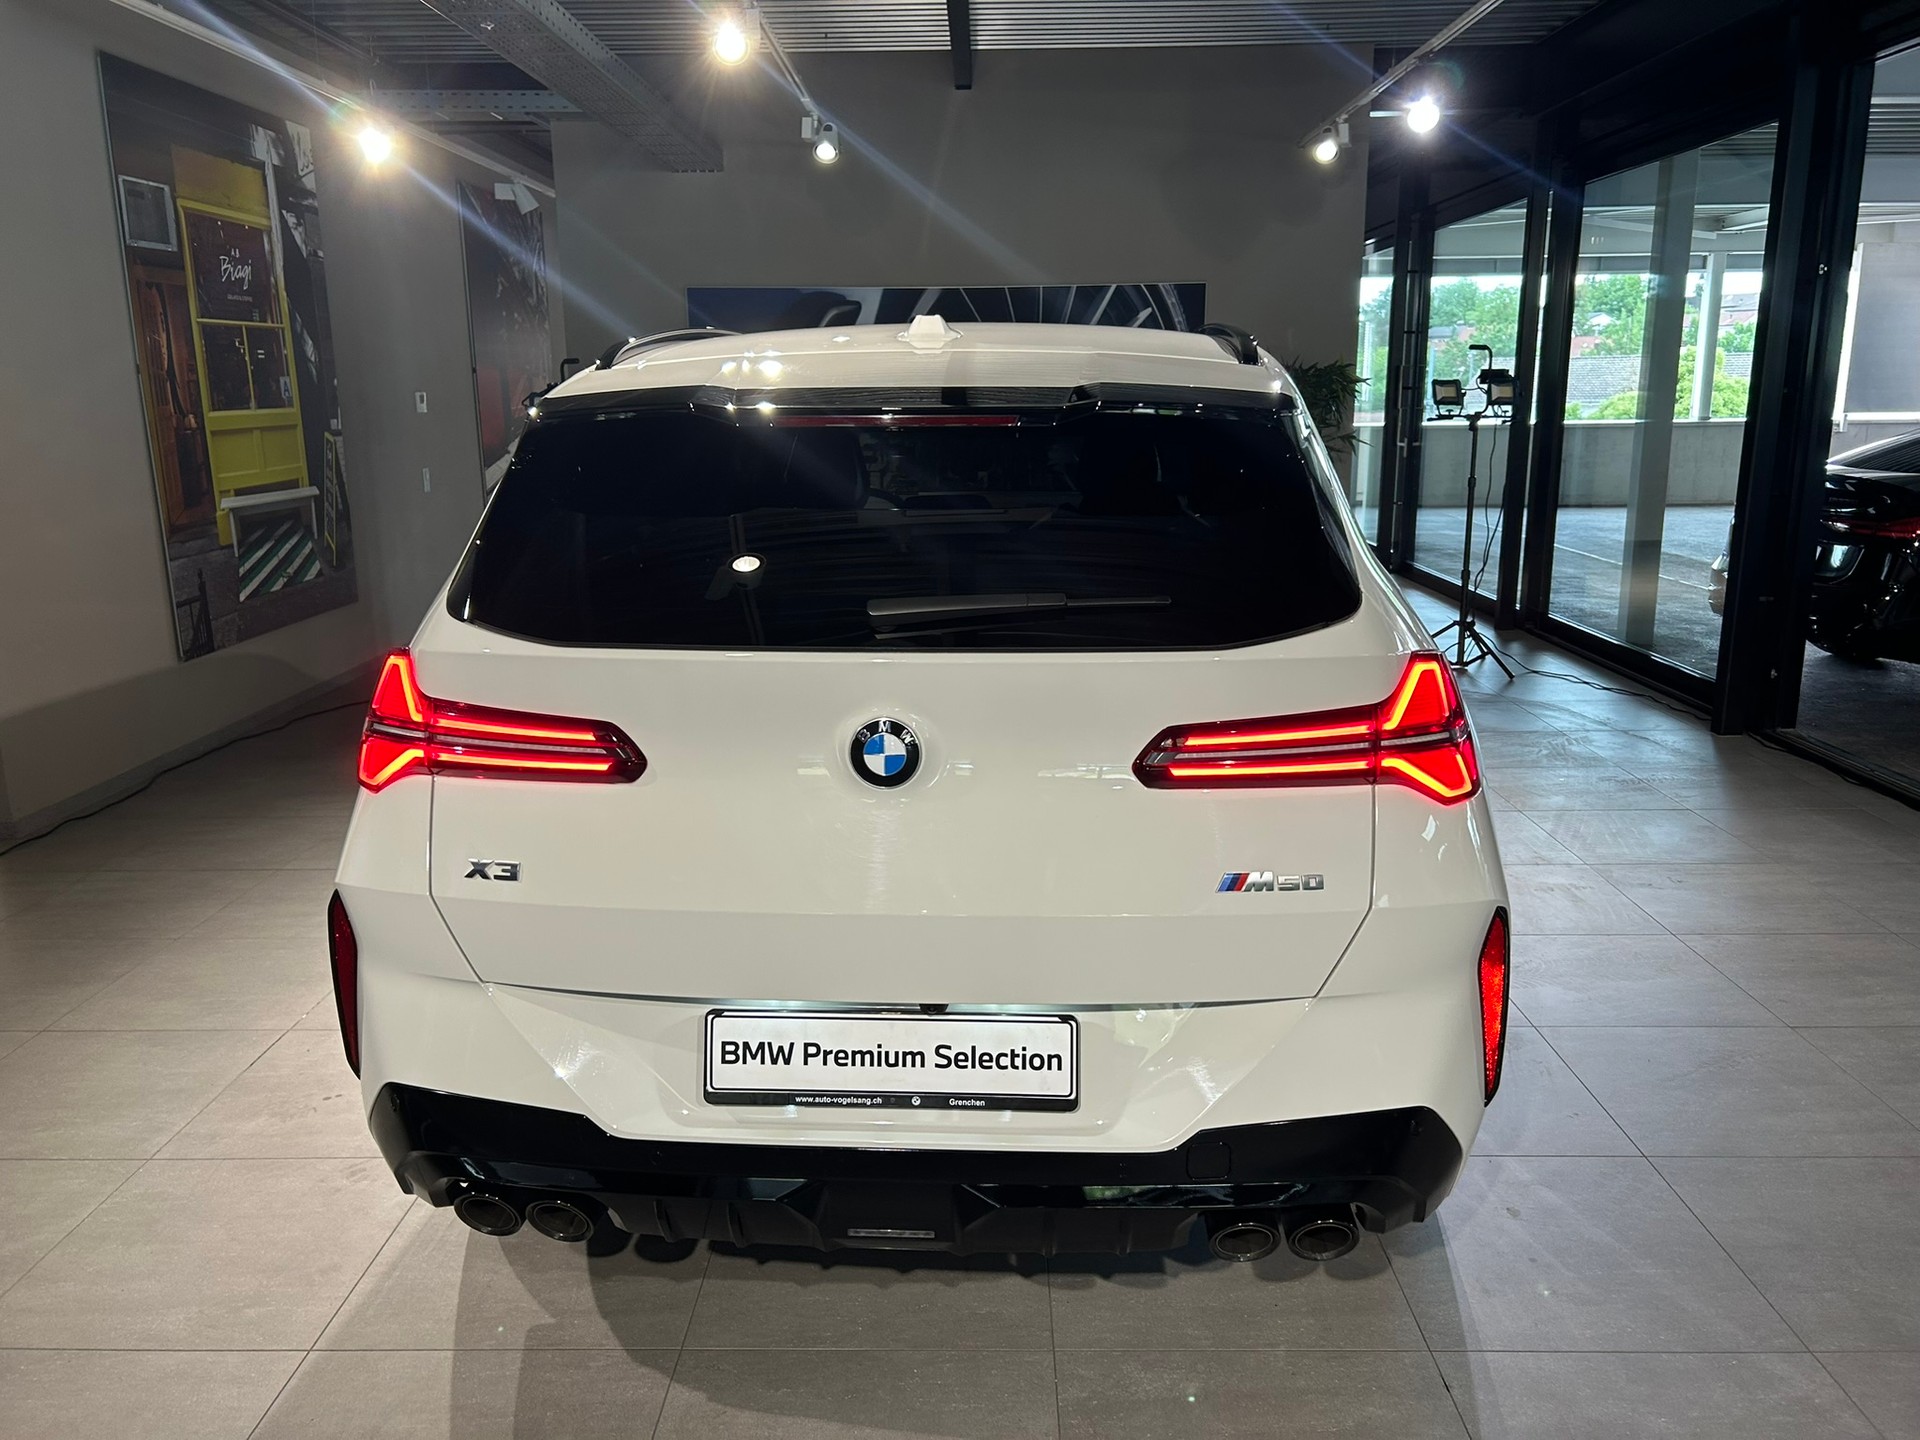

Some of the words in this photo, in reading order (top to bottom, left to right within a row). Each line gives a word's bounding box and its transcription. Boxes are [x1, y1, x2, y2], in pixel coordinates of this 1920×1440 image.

[219, 255, 252, 290] Biagi
[857, 720, 914, 746] BMW
[464, 858, 521, 881] X3
[1242, 871, 1325, 892] M50
[720, 1040, 794, 1066] BMW
[802, 1042, 926, 1068] Premium
[934, 1044, 1063, 1072] Selection
[795, 1095, 882, 1106] www.auto-vogelsang.ch
[949, 1098, 985, 1108] Grenchen
